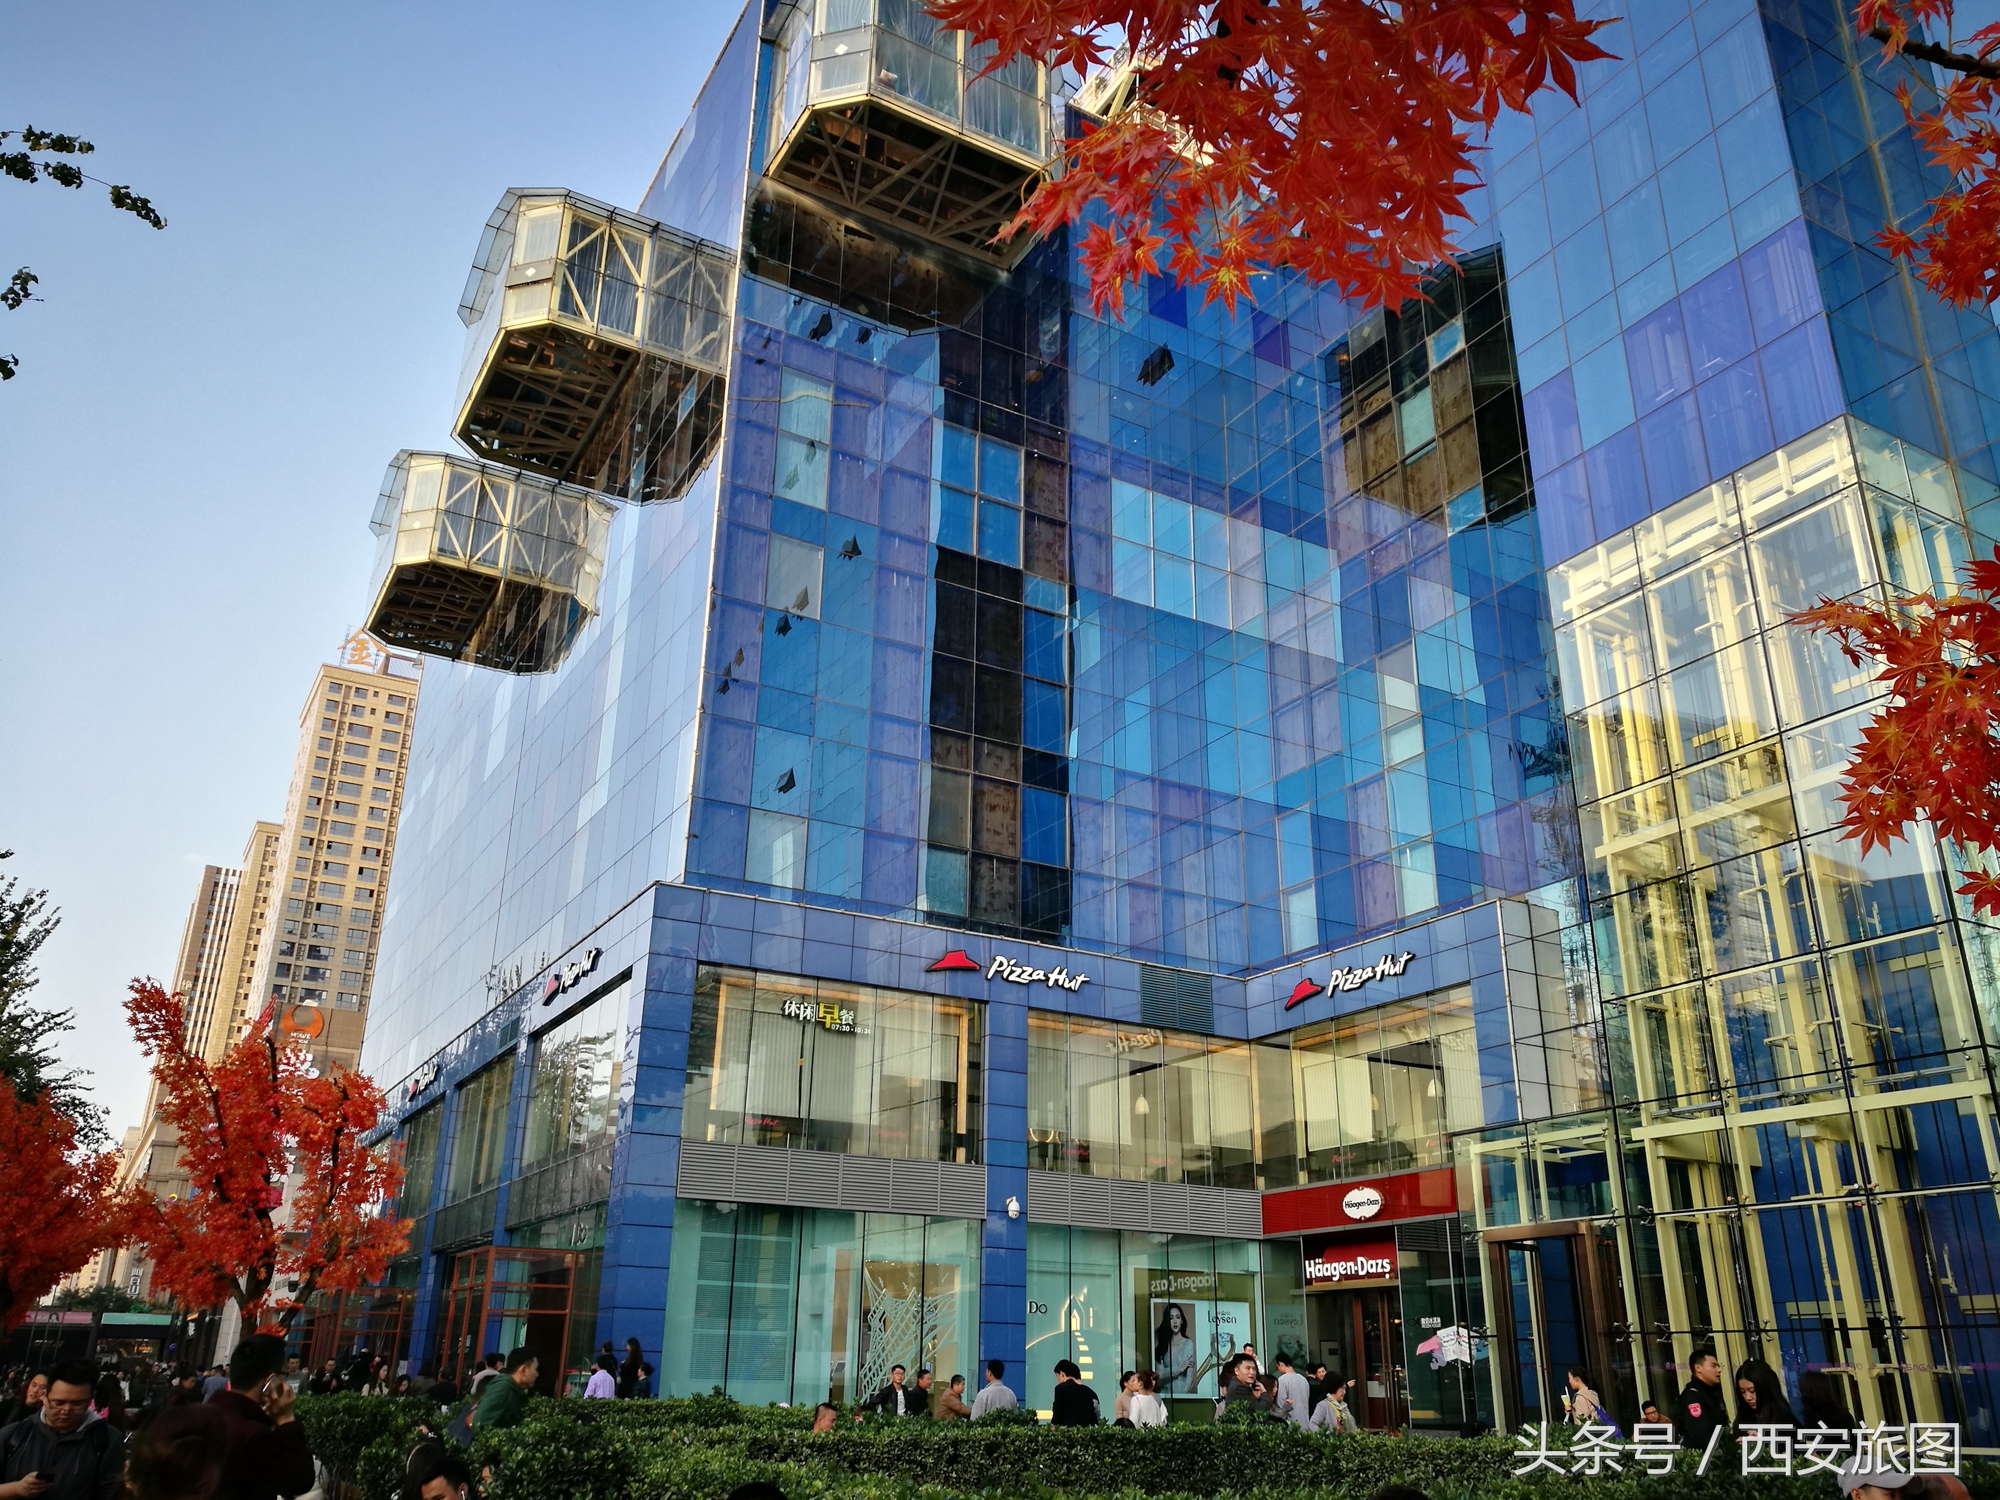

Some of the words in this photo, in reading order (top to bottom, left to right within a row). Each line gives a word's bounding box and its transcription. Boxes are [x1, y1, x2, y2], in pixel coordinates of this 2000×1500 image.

[337, 628, 392, 668] 金
[986, 956, 1046, 984] Pizza
[1048, 966, 1090, 991] Hut
[1327, 966, 1374, 997] Pizza
[1375, 952, 1413, 981] Hut
[784, 1000, 855, 1028] 休闲早餐
[1305, 1257, 1391, 1281] Häagen-Dazs
[1029, 1301, 1048, 1314] Do
